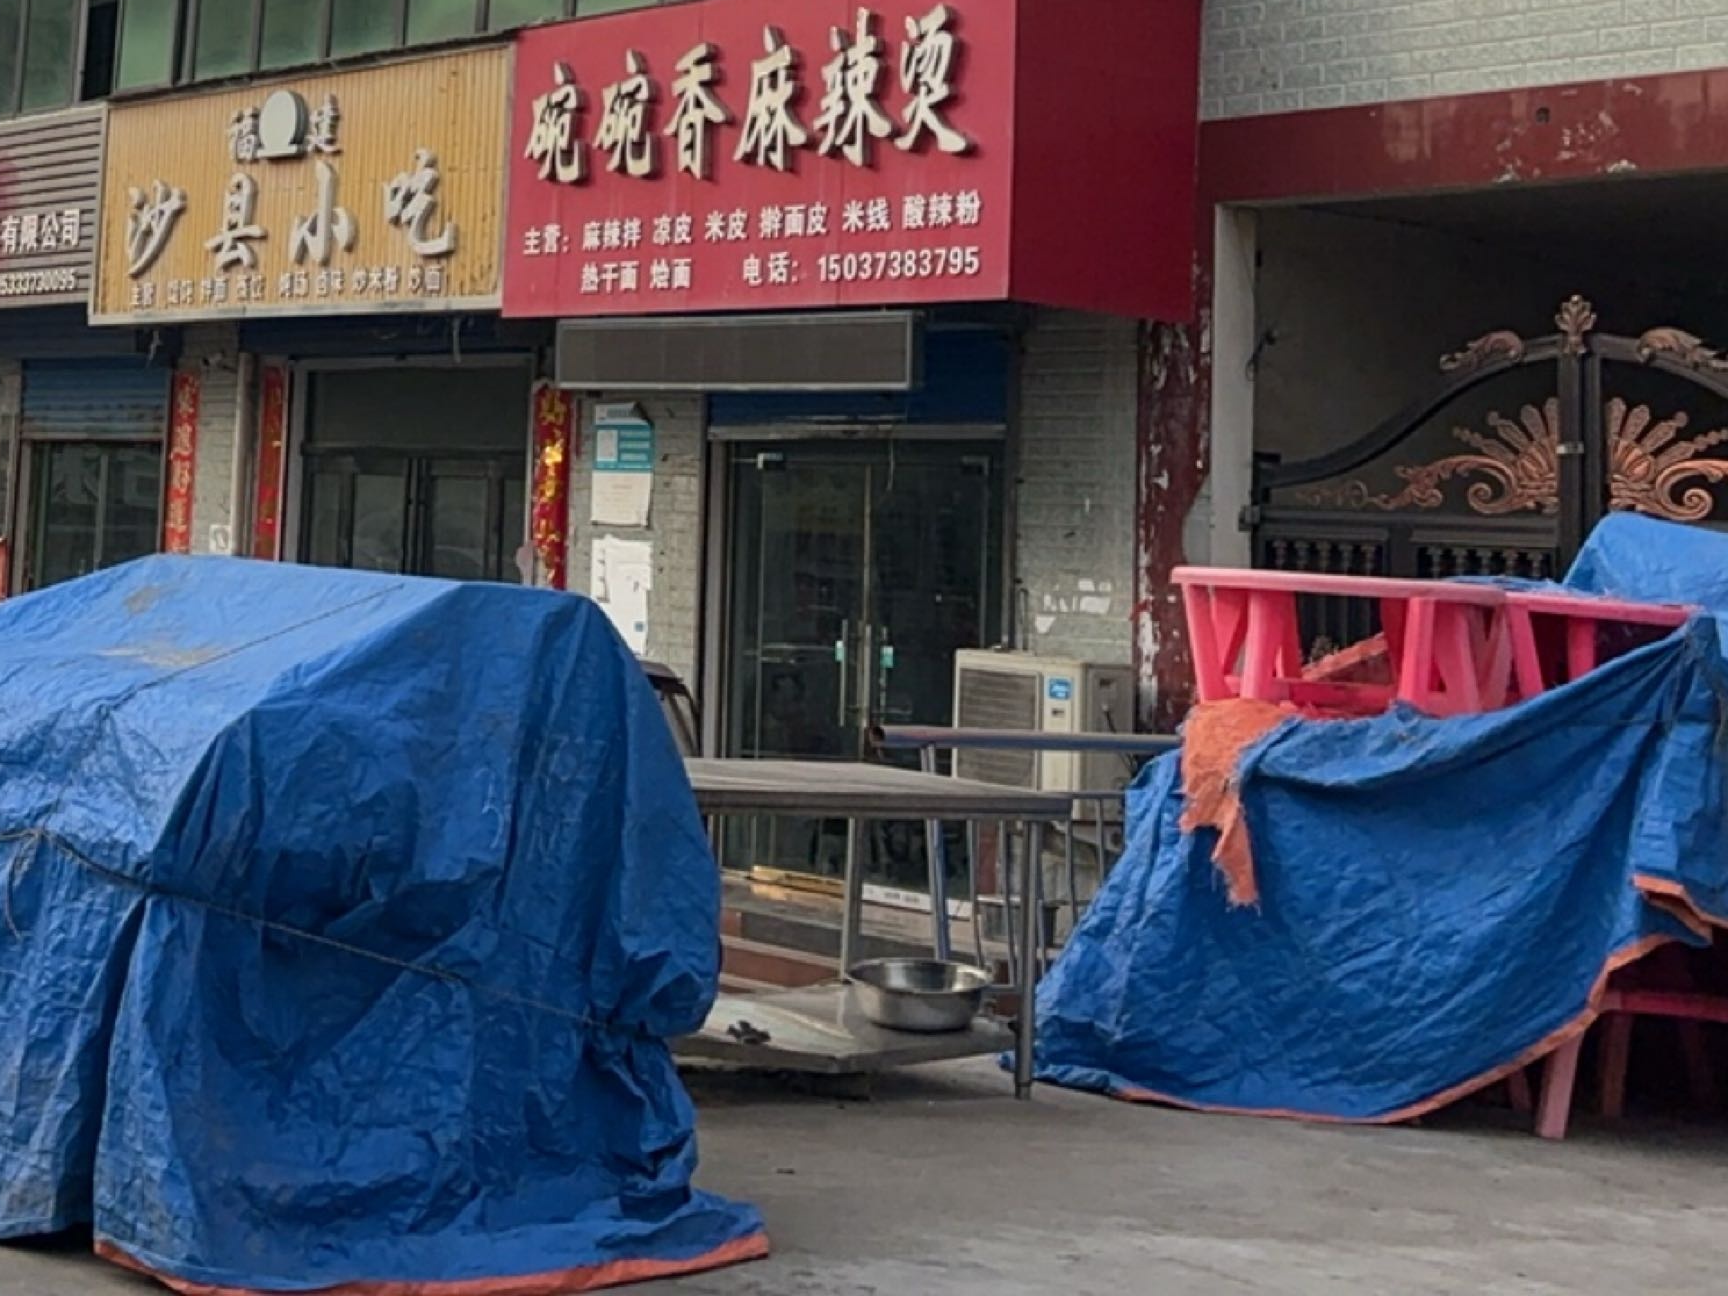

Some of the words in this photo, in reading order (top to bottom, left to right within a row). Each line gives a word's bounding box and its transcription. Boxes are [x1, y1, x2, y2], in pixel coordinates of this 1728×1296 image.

[523, 3, 976, 184] 碗碗香麻辣烫
[1, 208, 82, 255] 有限公司
[126, 146, 459, 279] 沙县小吃
[704, 207, 749, 244] 米皮
[841, 196, 892, 233] 米线
[901, 188, 982, 231] 酸辣粉
[580, 259, 641, 295] 热干面
[816, 245, 981, 283] 15037383795
